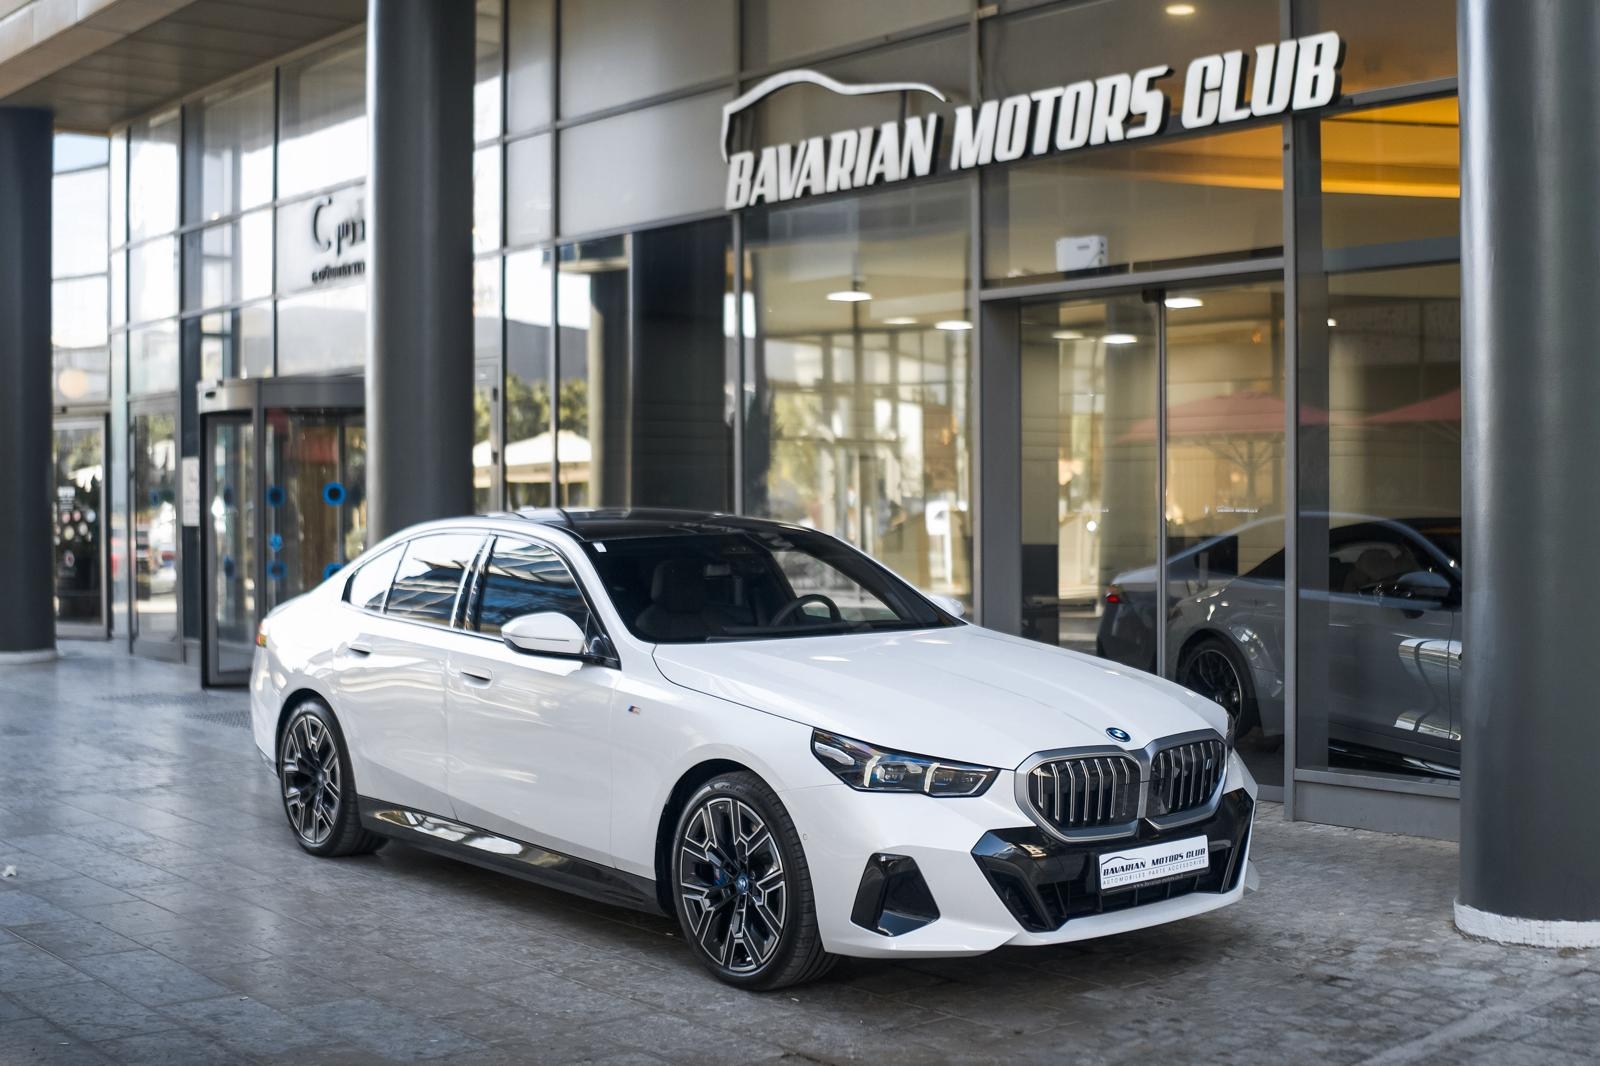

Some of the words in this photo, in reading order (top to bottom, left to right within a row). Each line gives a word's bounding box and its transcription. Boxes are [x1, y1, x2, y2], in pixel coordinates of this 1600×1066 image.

[724, 113, 940, 211] BAVARIAN
[949, 65, 1173, 170] MOTORS
[1181, 31, 1342, 130] CLUB
[1103, 861, 1146, 876] BAVARIAN
[1151, 853, 1184, 867] MOTORS
[1185, 847, 1206, 859] CLUB
[1103, 872, 1145, 885] AUTOMOBILES
[1168, 858, 1205, 871] ACCESSORIES
